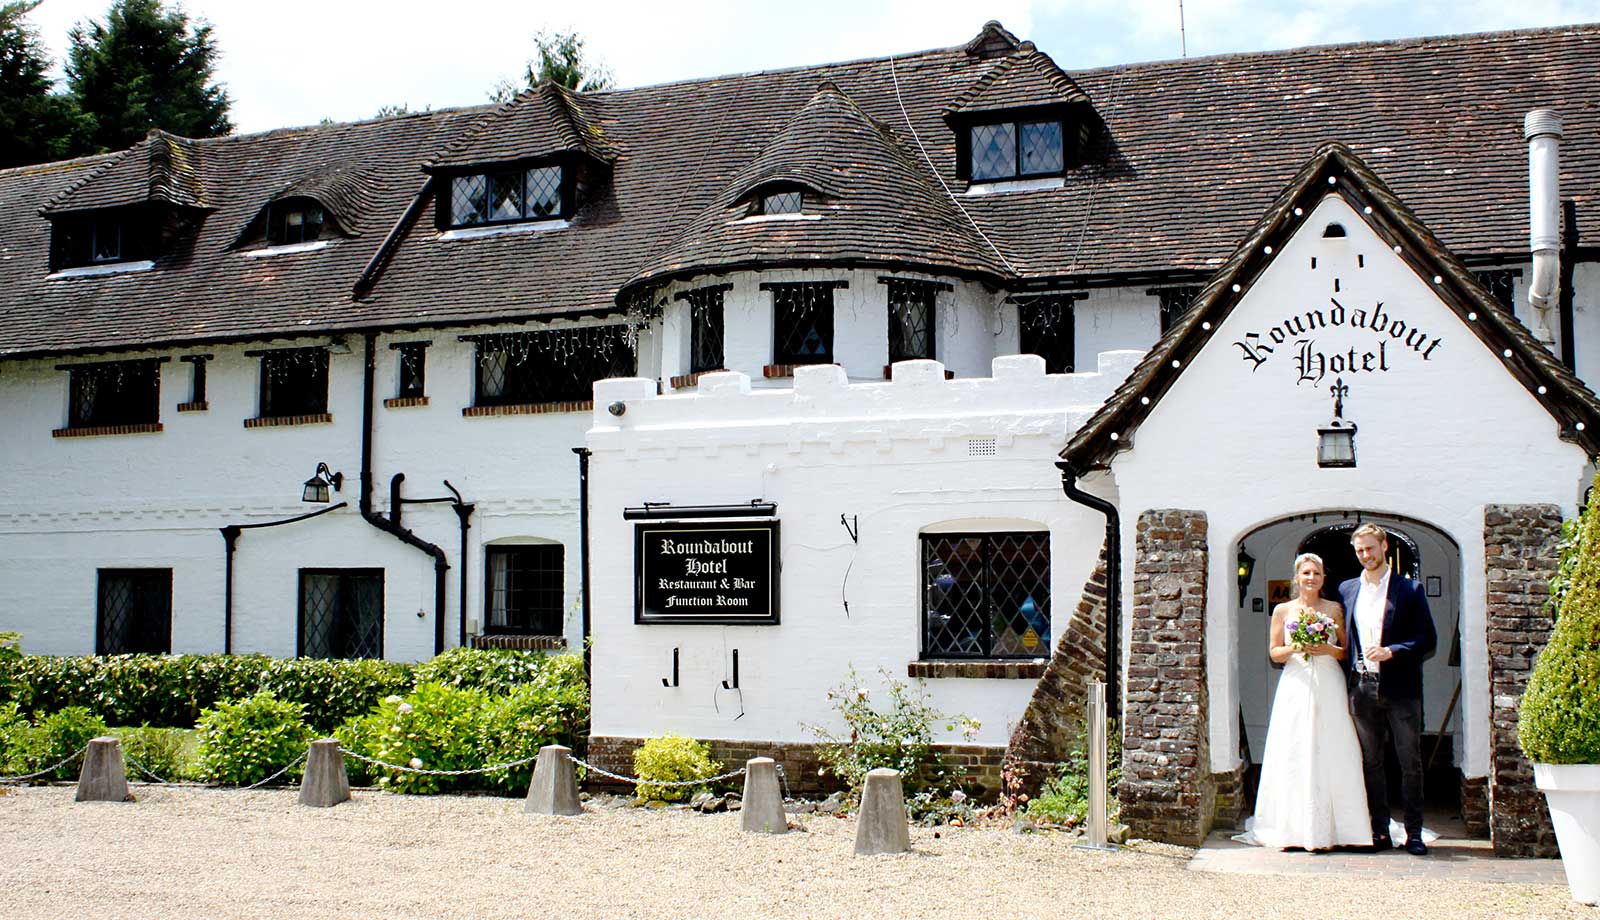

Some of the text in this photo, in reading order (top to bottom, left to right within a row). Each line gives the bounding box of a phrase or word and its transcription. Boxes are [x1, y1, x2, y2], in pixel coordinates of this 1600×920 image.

[1232, 297, 1442, 373] Roundabout
[1292, 339, 1391, 388] Hotel
[660, 538, 753, 555] Roundabout
[685, 557, 728, 577] Hotel
[658, 577, 756, 590] Restaurant & Bar
[665, 594, 749, 608] Function Room
